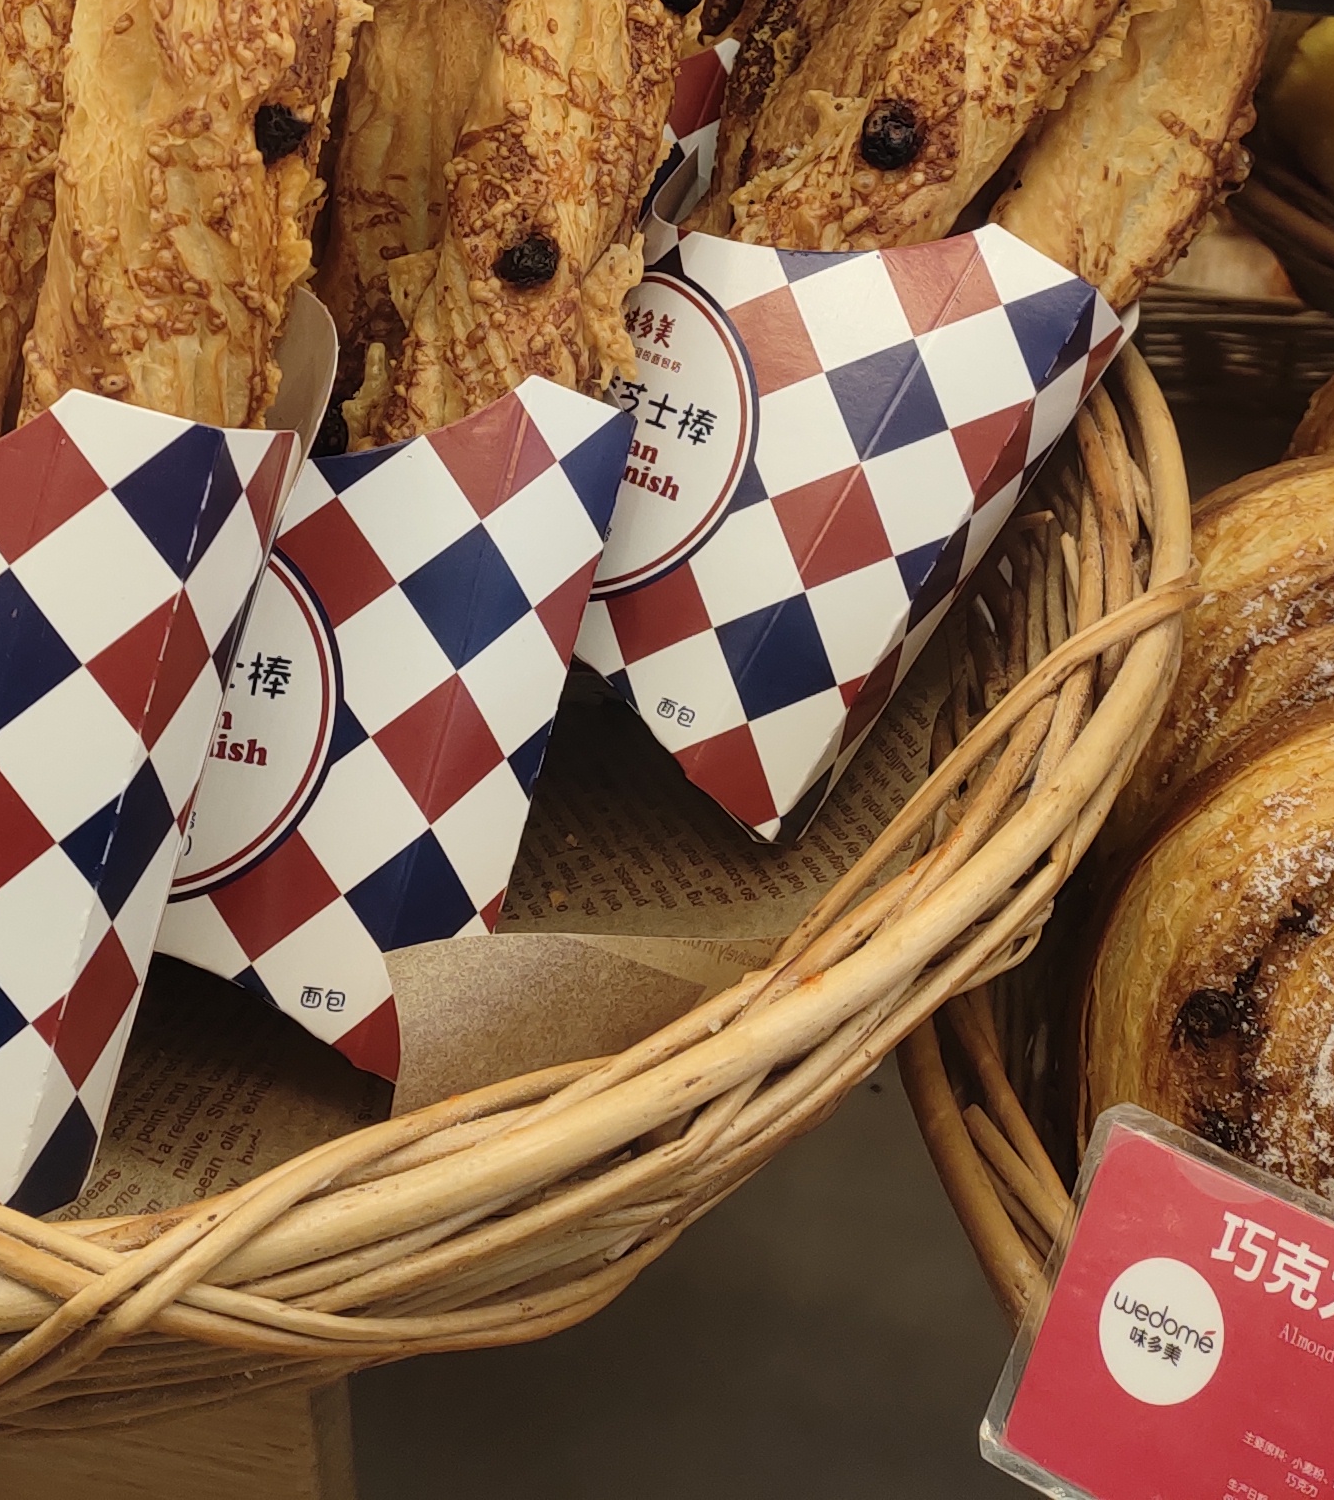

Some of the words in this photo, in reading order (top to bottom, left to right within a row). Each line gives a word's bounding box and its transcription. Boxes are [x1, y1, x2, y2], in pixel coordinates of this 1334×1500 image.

[610, 375, 718, 446] 芝士棒
[230, 652, 292, 700] 棒
[656, 697, 696, 728] 面包
[800, 855, 829, 884] more
[300, 985, 346, 1012] 面包
[136, 1109, 168, 1144] point
[220, 1122, 249, 1151] oils,
[172, 1129, 214, 1181] native.
[1113, 1291, 1217, 1354] wedomé
[1129, 1326, 1183, 1367] 味多美
[1284, 1471, 1319, 1499] 巧克力
